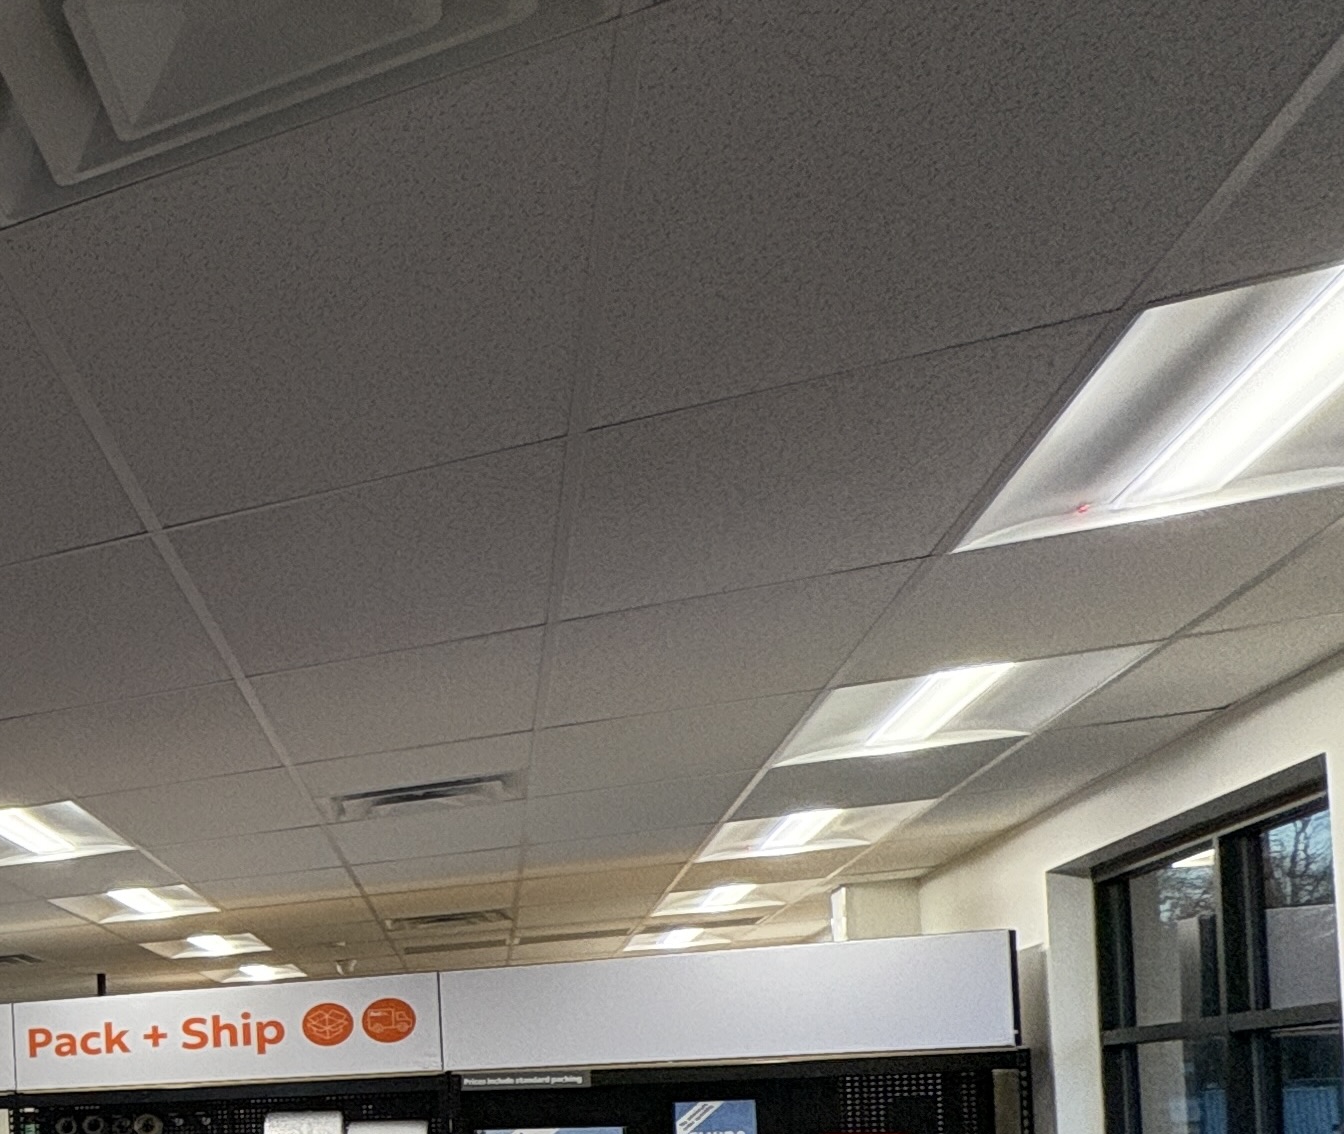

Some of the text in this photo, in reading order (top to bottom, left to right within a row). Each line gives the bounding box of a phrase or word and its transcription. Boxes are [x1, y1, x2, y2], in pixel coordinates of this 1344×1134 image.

[28, 1011, 285, 1058] Pack + Ship
